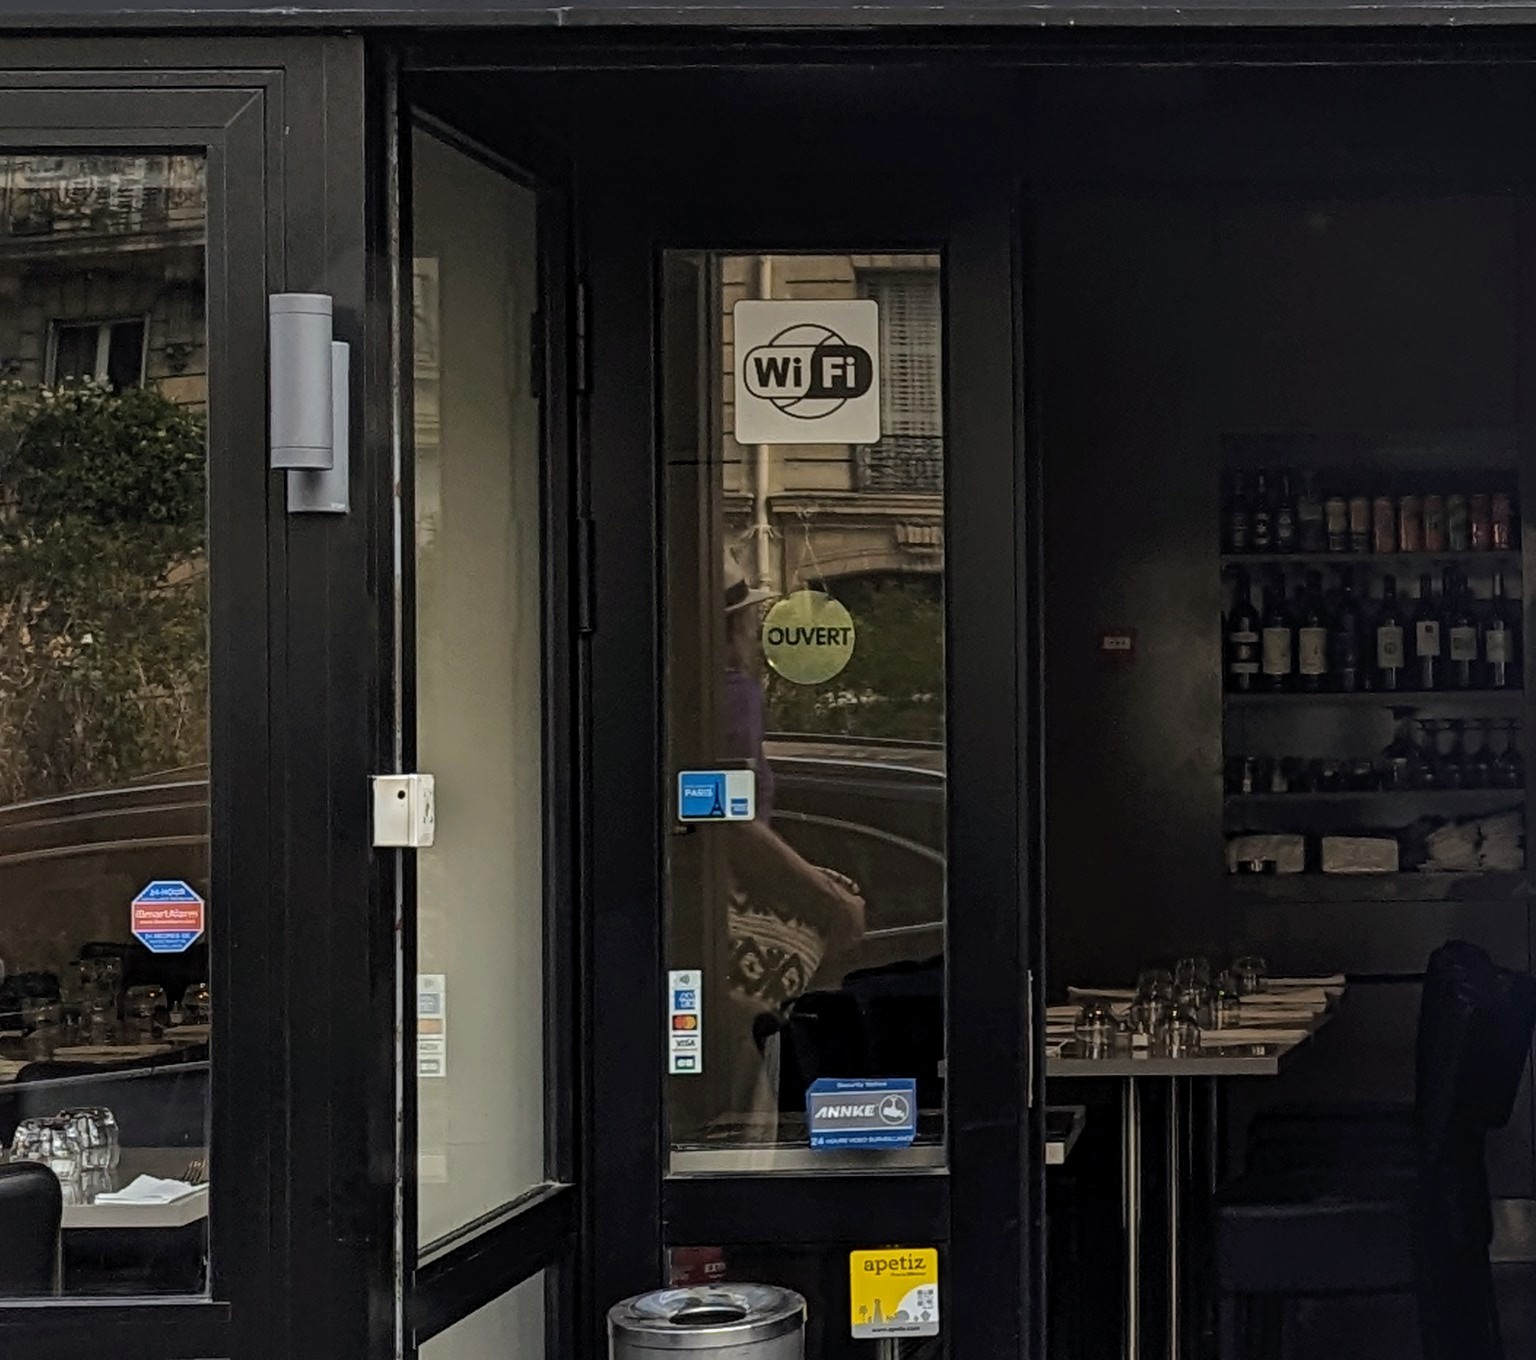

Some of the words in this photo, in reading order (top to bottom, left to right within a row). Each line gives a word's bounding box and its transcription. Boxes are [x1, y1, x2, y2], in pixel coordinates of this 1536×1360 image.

[768, 627, 852, 646] OUVERT
[815, 1104, 876, 1119] ANNKE
[864, 1253, 927, 1276] apetiz
